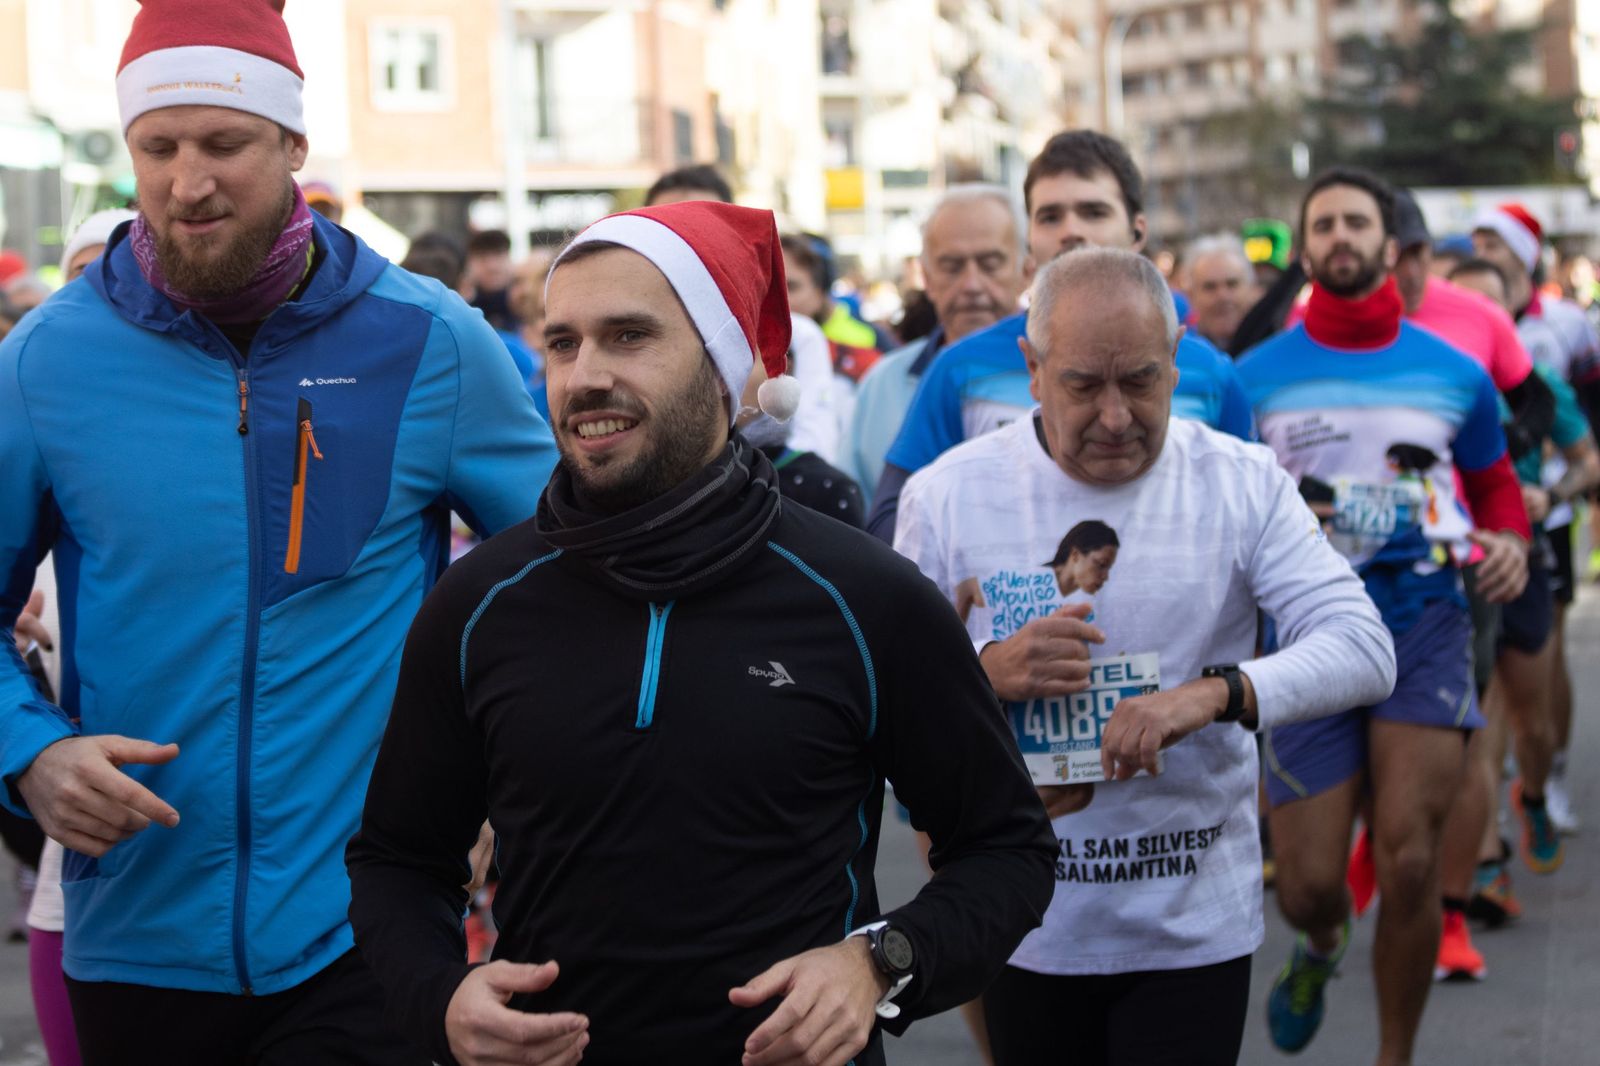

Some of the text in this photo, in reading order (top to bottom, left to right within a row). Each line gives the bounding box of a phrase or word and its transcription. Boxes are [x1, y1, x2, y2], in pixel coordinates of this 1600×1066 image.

[1089, 662, 1143, 685] TEL
[1083, 838, 1129, 859] SAN
[1055, 854, 1197, 884] SALMANTINA
